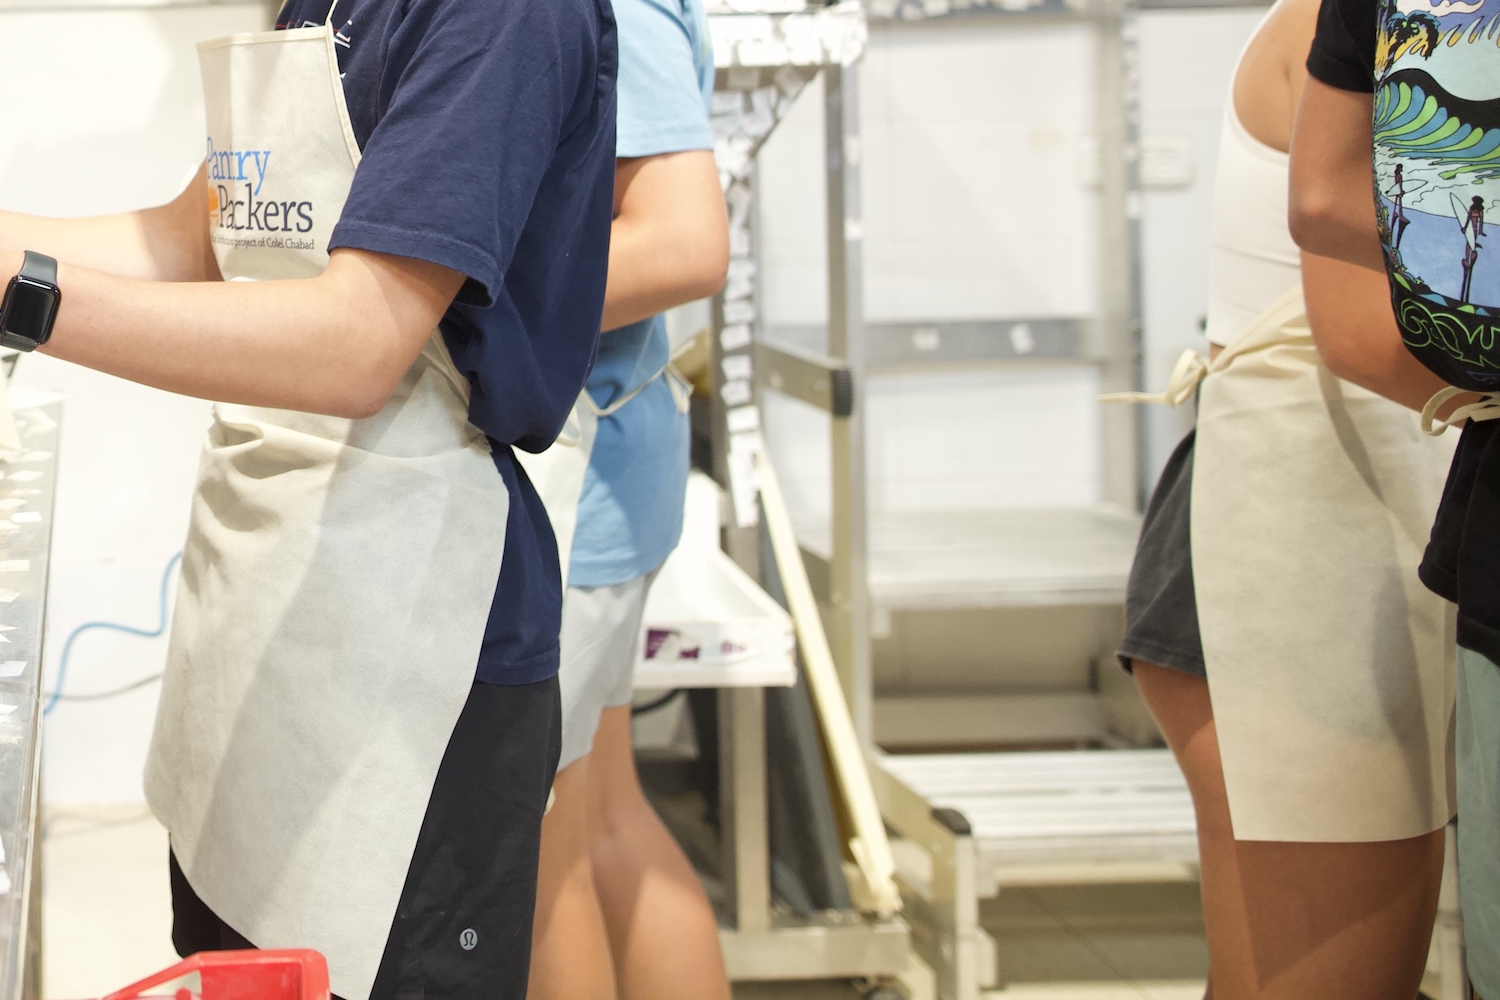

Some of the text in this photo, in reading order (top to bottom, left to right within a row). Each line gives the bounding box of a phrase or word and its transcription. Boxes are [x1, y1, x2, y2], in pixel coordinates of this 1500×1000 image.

[217, 182, 313, 233] Packers
[258, 237, 265, 248] of
[285, 238, 315, 250] Chabad
